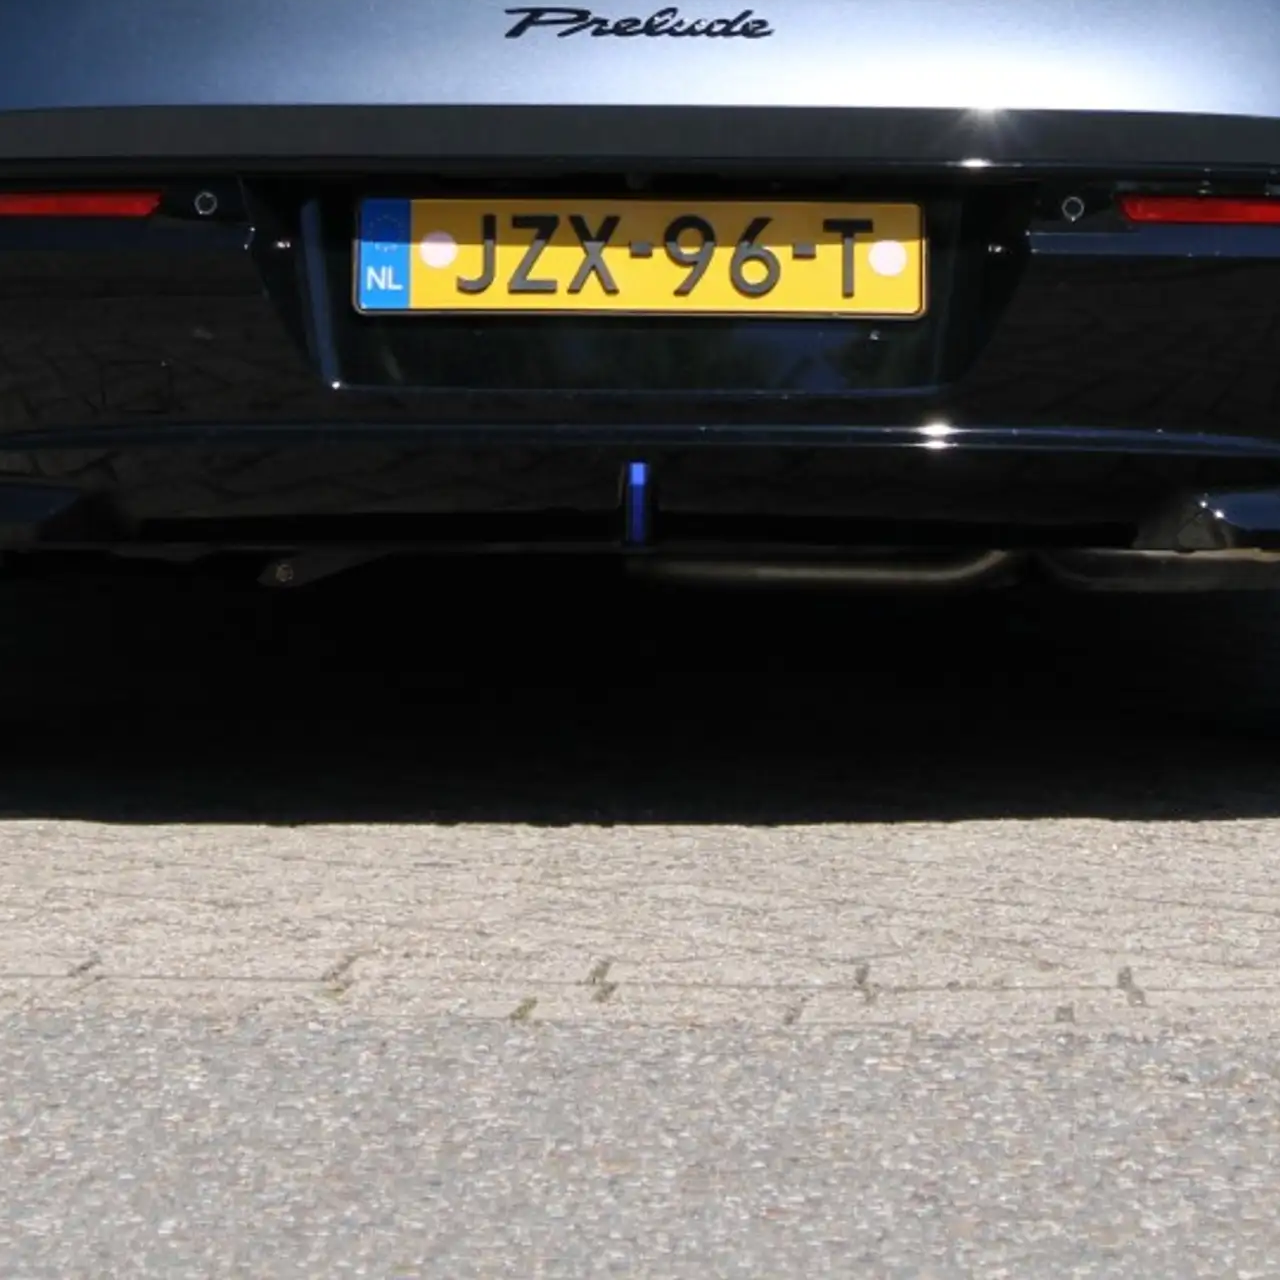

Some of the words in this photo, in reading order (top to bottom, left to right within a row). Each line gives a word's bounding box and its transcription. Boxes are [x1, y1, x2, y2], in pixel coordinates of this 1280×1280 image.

[504, 6, 774, 39] Prelude
[364, 265, 404, 292] NL
[456, 213, 874, 298] JZX-96-T
